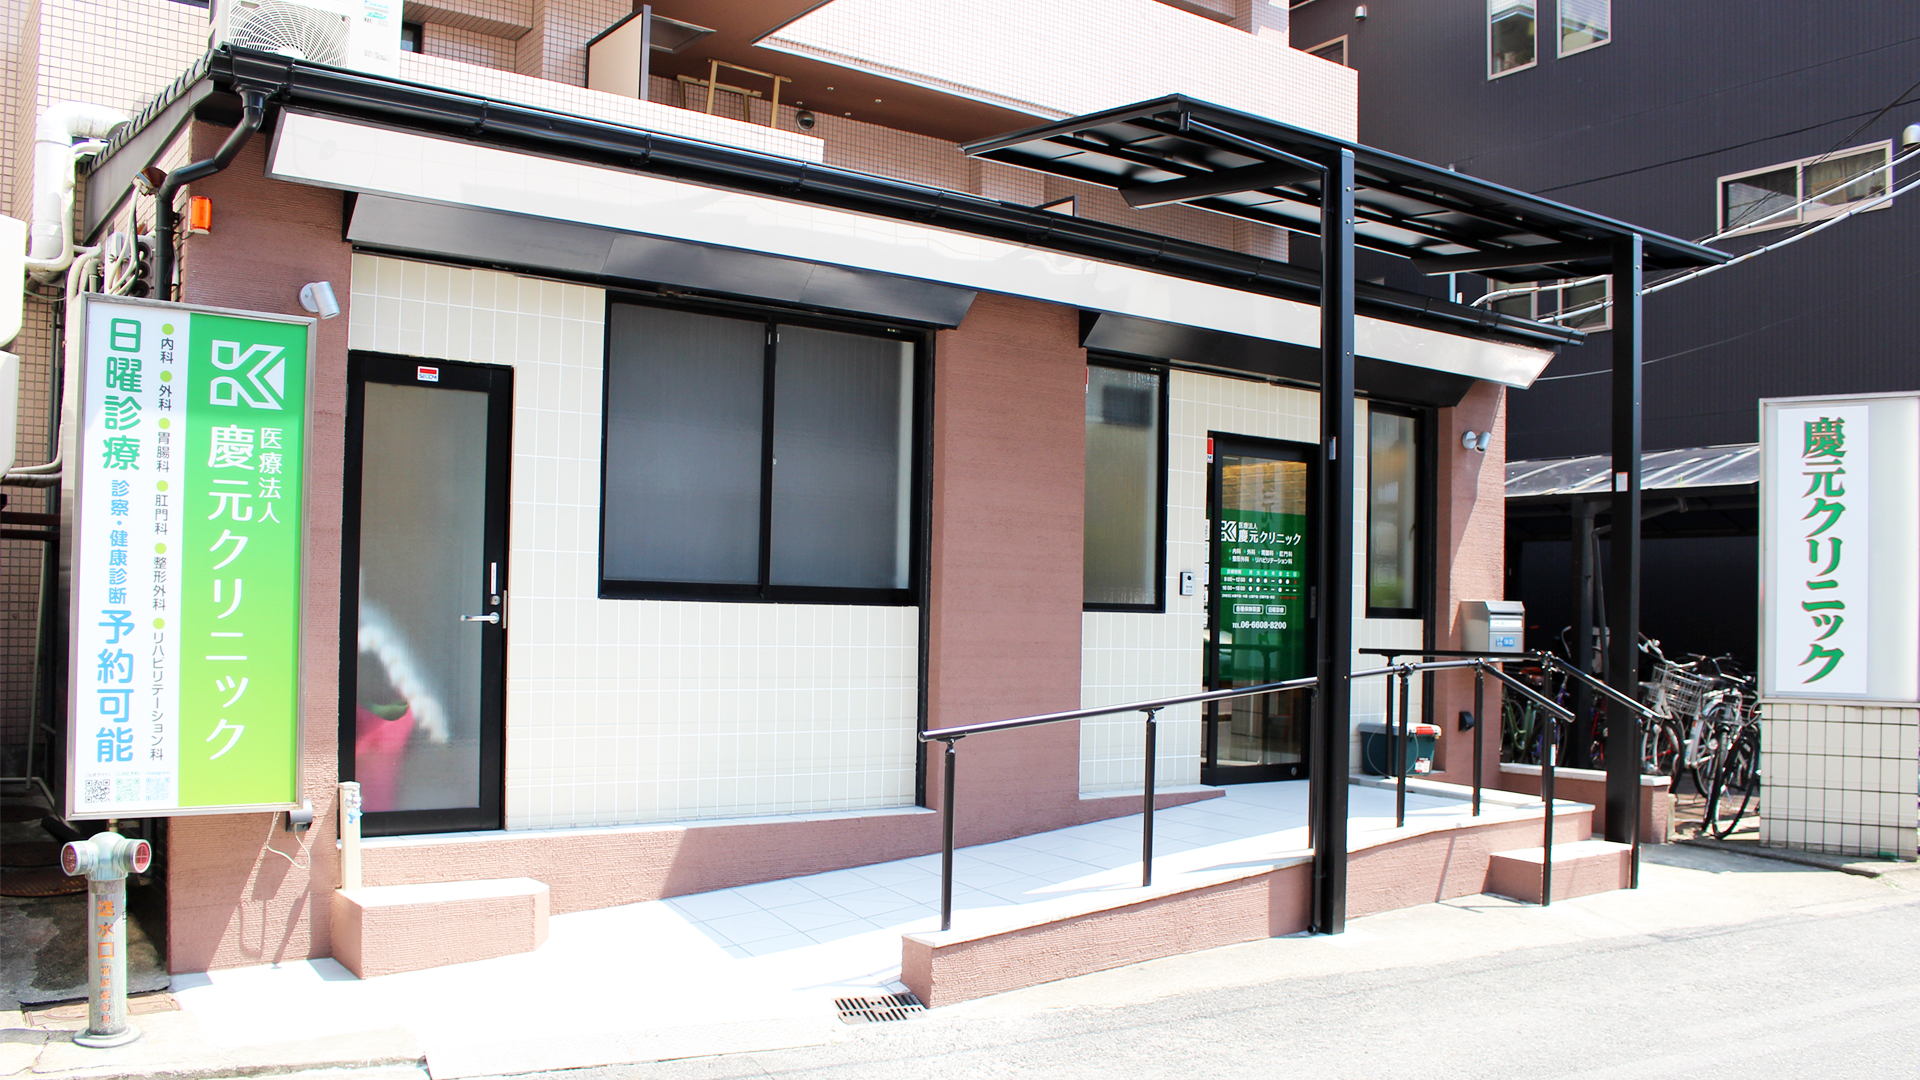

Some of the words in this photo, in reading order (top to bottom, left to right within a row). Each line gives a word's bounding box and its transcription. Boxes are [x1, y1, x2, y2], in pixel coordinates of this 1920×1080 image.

[159, 337, 174, 365] 内科
[102, 317, 143, 471] 日曜診療
[158, 384, 173, 412] 外科
[156, 431, 170, 473] 胃腸科
[257, 427, 283, 524] 医療法人
[108, 479, 130, 605] 診察・健康診断
[155, 494, 169, 535] 肛門科
[1238, 521, 1258, 530] 医療法人
[1238, 529, 1302, 546] 慶元クリニック
[1798, 416, 1848, 685] 慶元クリニック
[152, 556, 167, 611] 整形外科
[206, 425, 256, 761] 慶元クリニック
[96, 609, 135, 763] 予約可能
[150, 632, 165, 760] リハビリテーション科
[97, 900, 115, 960] 送水口
